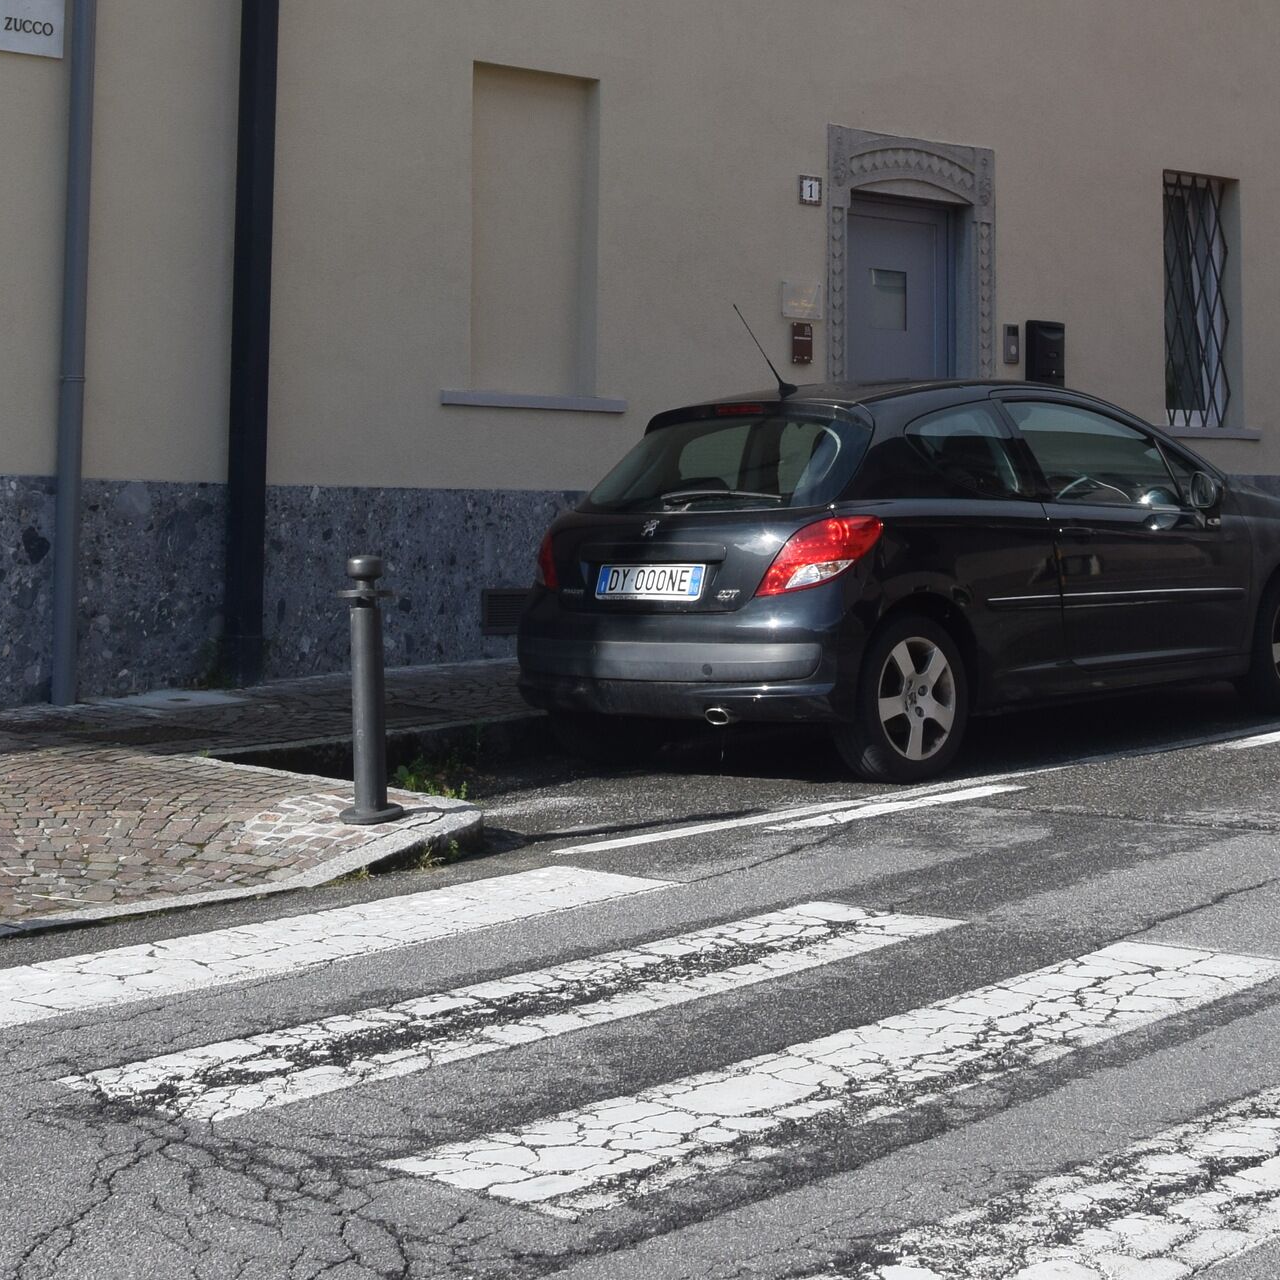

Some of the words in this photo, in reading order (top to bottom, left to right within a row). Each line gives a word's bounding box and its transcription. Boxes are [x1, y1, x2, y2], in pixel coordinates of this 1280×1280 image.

[4, 16, 54, 36] ZUCCO
[807, 182, 814, 199] 1
[608, 568, 631, 592] DY
[634, 568, 690, 592] 000NE
